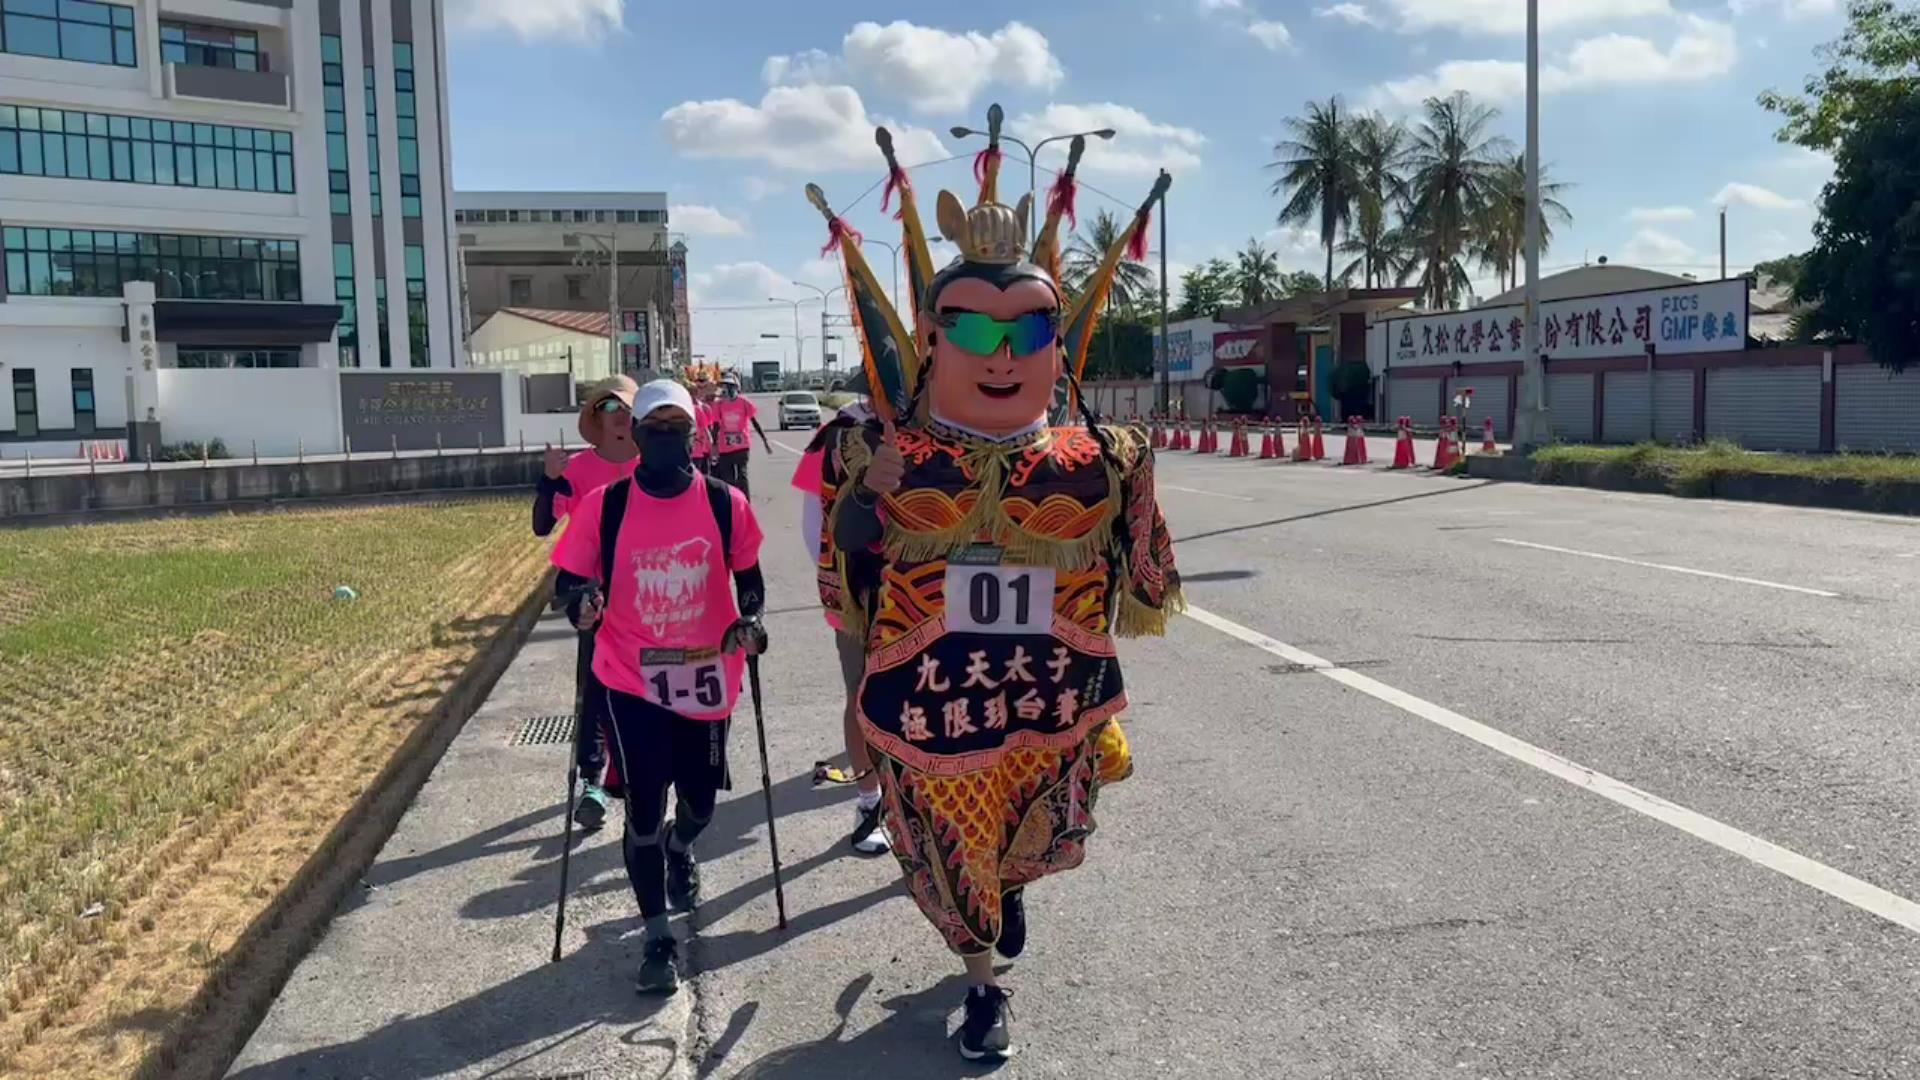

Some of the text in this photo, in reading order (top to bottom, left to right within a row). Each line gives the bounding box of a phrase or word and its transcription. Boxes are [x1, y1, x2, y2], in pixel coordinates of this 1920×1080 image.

[1422, 305, 1652, 356] 久松化學企業份有限公司
[1661, 315, 1699, 342] GMP
[969, 572, 1030, 625] 01
[650, 664, 723, 707] 1-5
[915, 645, 1073, 692] 九天太子
